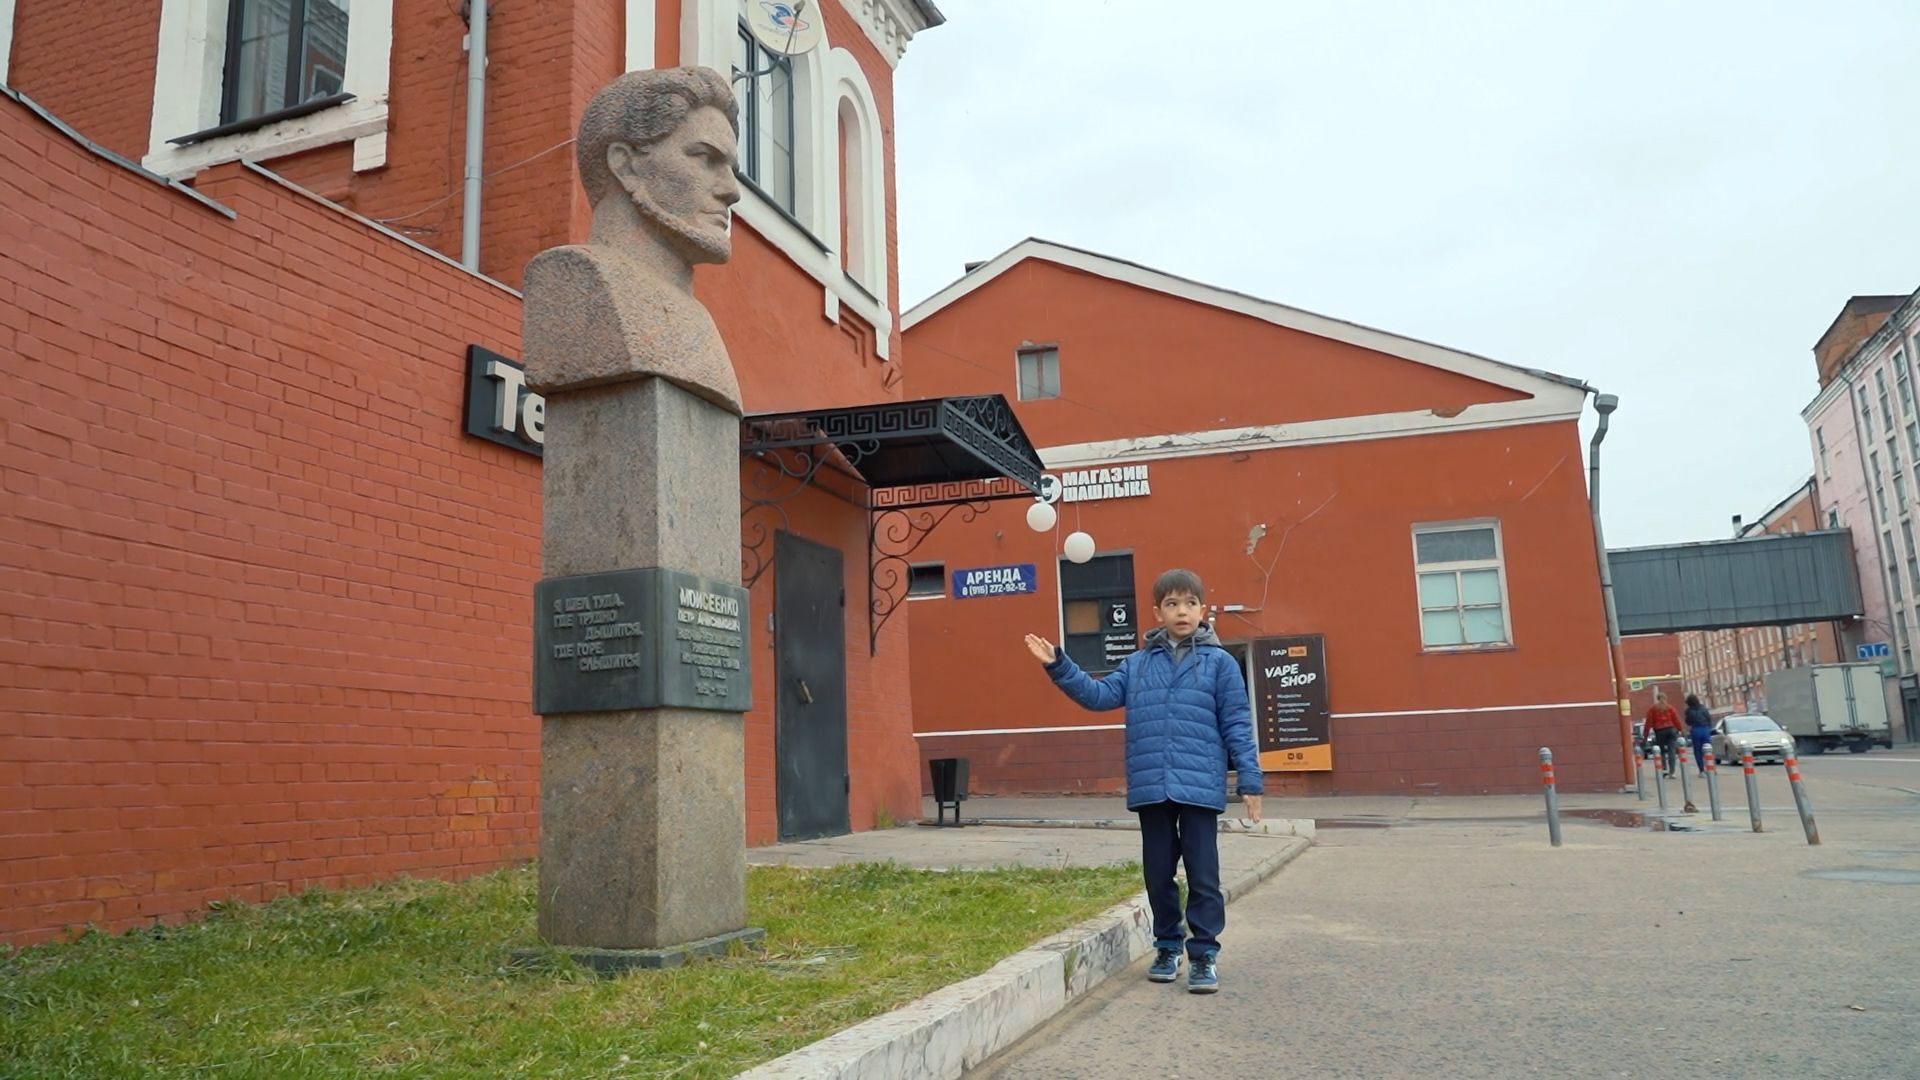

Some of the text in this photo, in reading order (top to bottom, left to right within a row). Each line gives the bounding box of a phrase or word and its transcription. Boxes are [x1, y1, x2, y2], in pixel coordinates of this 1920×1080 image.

[1062, 465, 1148, 486] МАГАЗИН
[1063, 480, 1151, 502] ШАШЛЫКА
[966, 567, 1022, 586] АРЕНДА
[961, 586, 969, 596] 8
[565, 597, 591, 611] ШЕЛ
[679, 587, 739, 617] МОИСЕЕНКО
[553, 609, 617, 628] ГДЕ ТРУДНО
[553, 643, 574, 658] ГДЕ
[1270, 649, 1287, 657] ПАР
[1264, 663, 1299, 679] VAPE
[1280, 672, 1317, 688] SHOP
